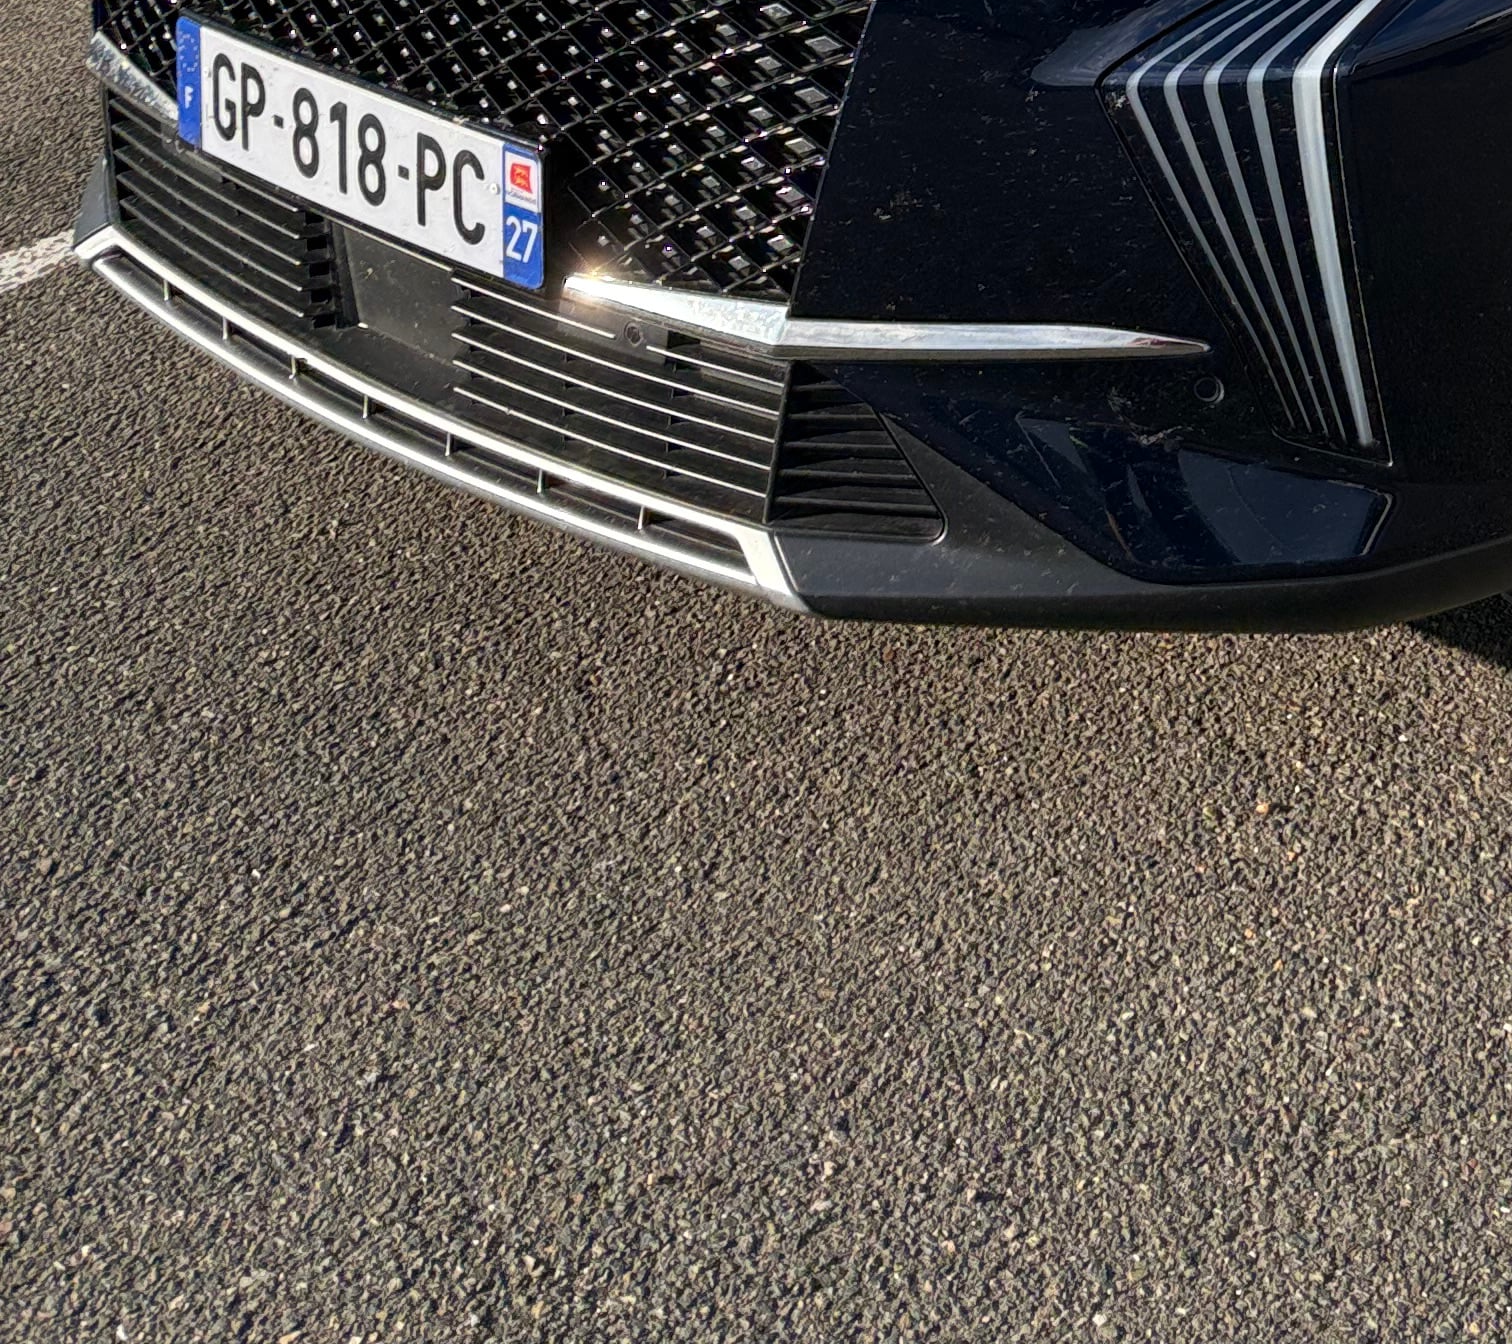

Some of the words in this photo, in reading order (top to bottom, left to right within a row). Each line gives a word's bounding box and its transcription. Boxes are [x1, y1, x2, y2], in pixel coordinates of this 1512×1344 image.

[184, 85, 194, 109] F
[212, 53, 486, 245] GP-818-PC
[505, 215, 538, 263] 27
